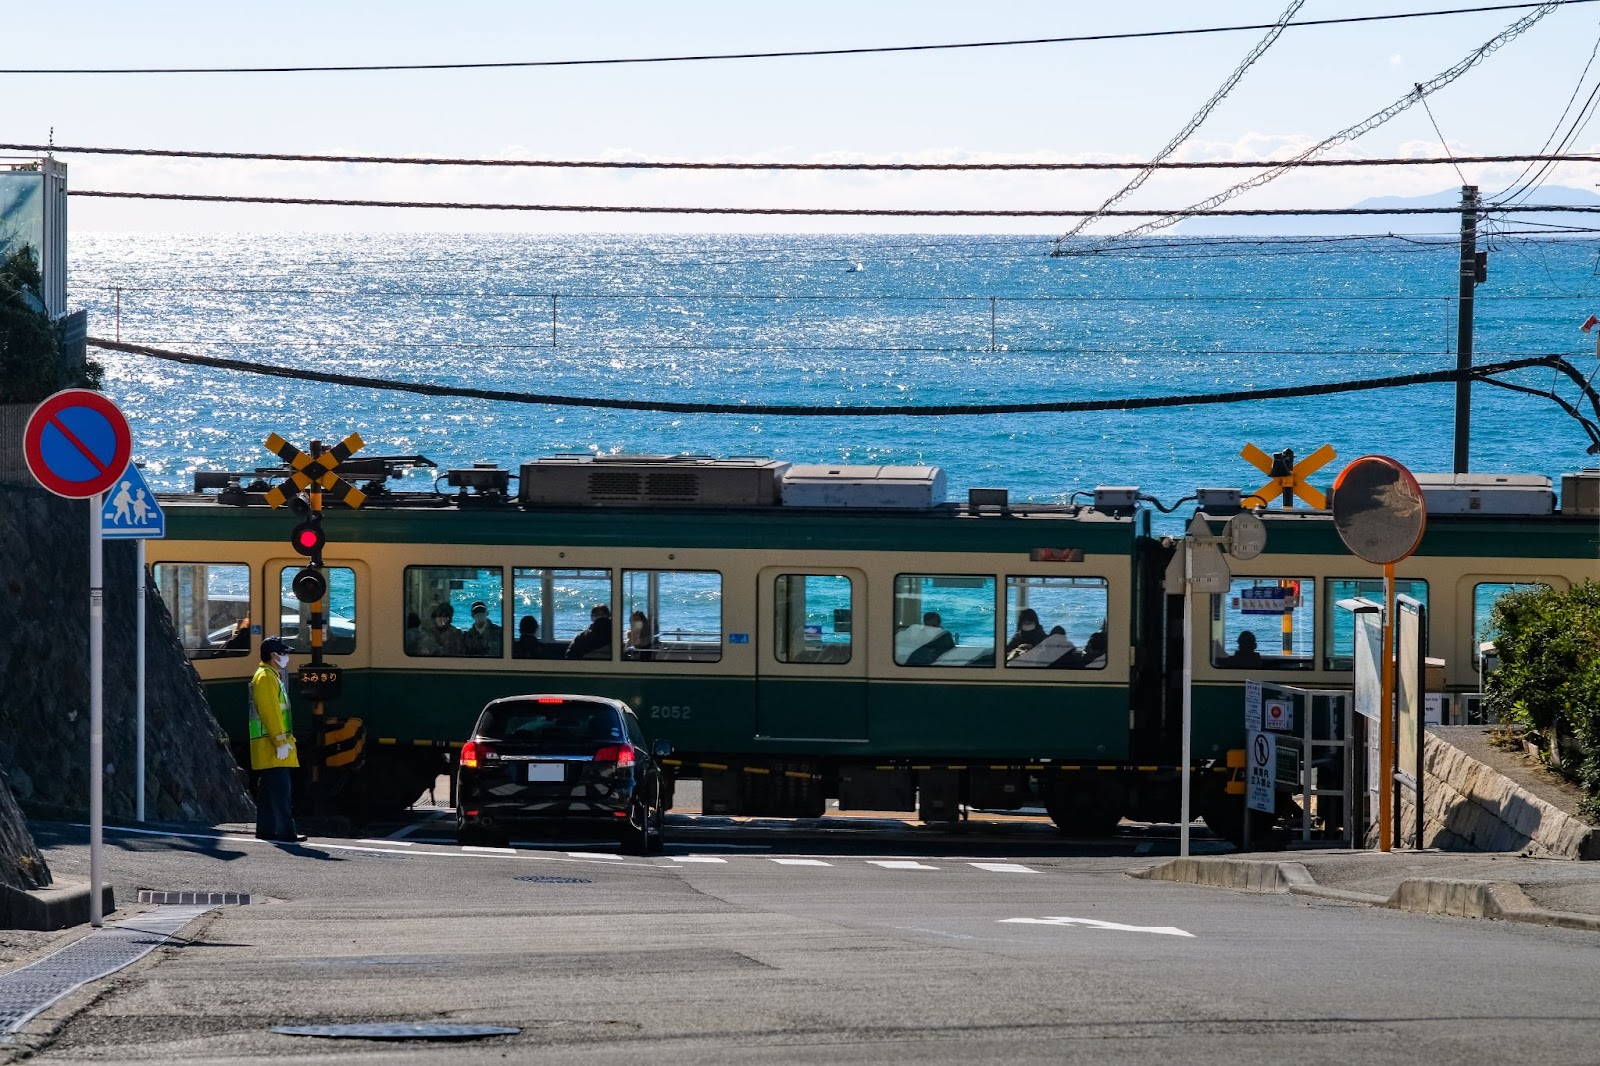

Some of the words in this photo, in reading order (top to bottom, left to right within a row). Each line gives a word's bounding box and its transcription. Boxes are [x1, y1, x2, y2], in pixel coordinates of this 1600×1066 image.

[301, 672, 337, 682] ふみきり
[651, 705, 691, 719] 2052
